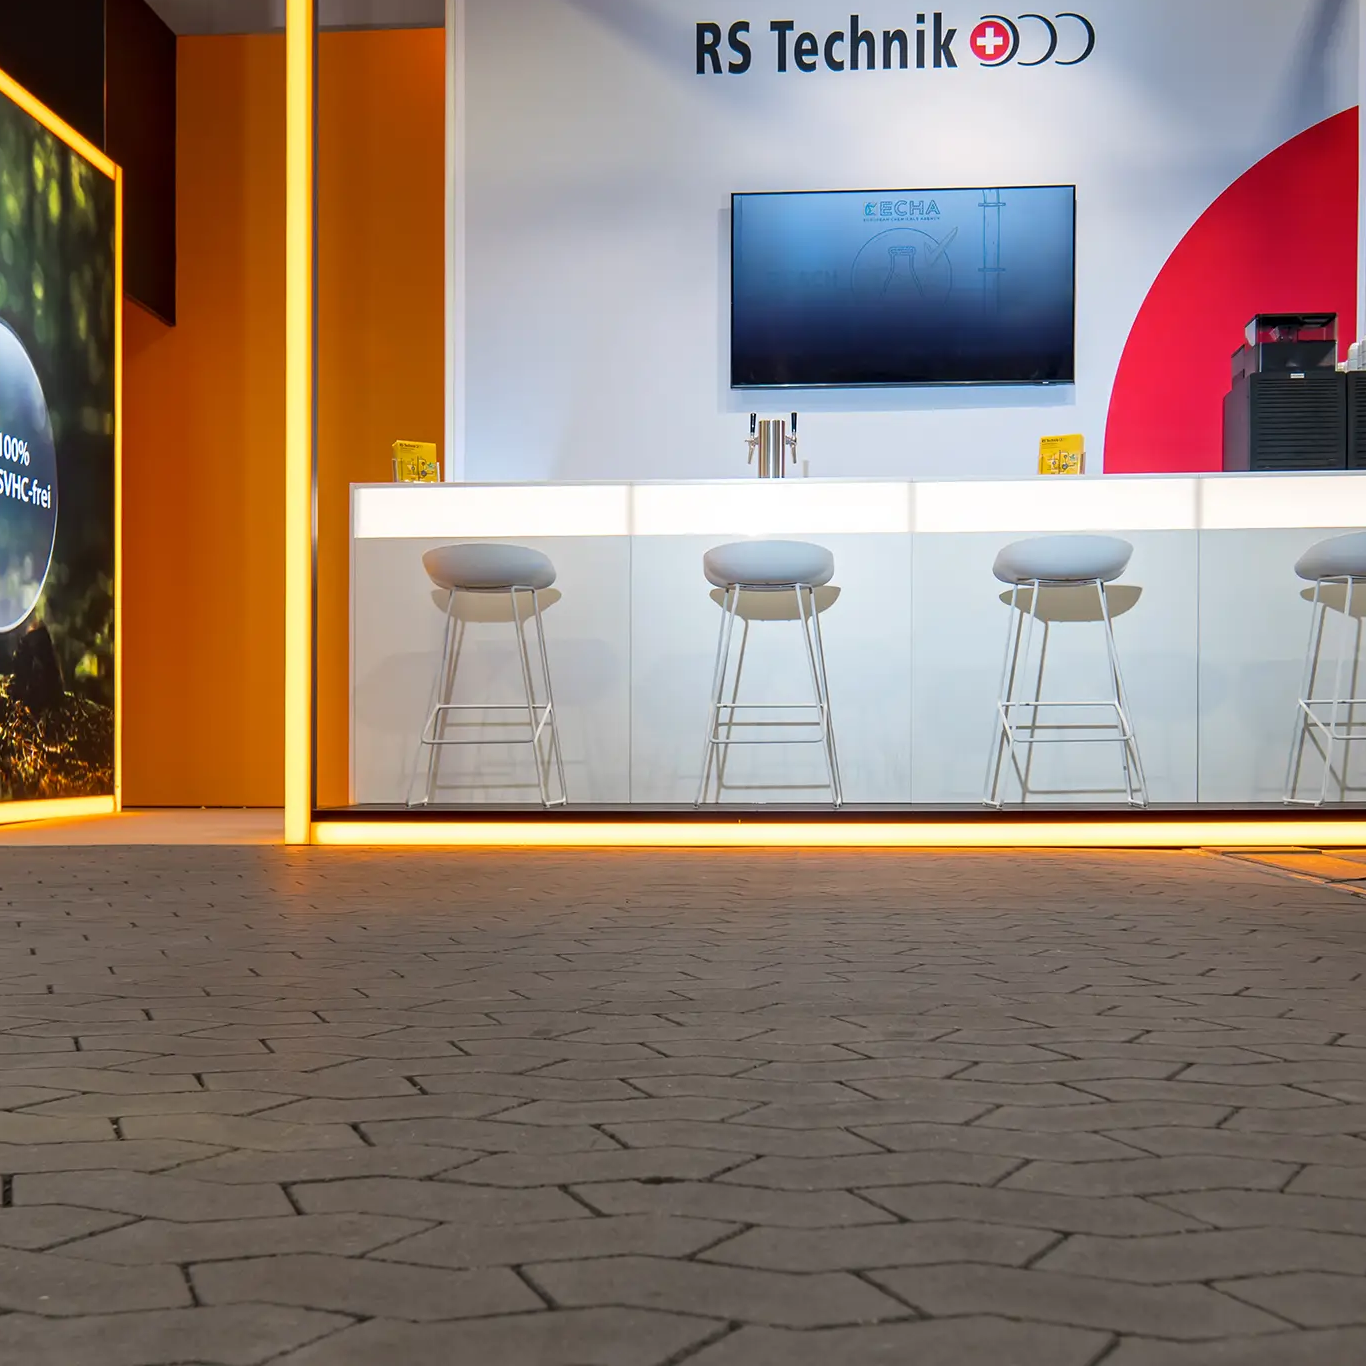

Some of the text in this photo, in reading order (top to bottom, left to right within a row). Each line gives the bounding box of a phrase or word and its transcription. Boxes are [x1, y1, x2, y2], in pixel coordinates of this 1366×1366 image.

[696, 13, 958, 74] RS Technik
[879, 199, 941, 217] ECHA
